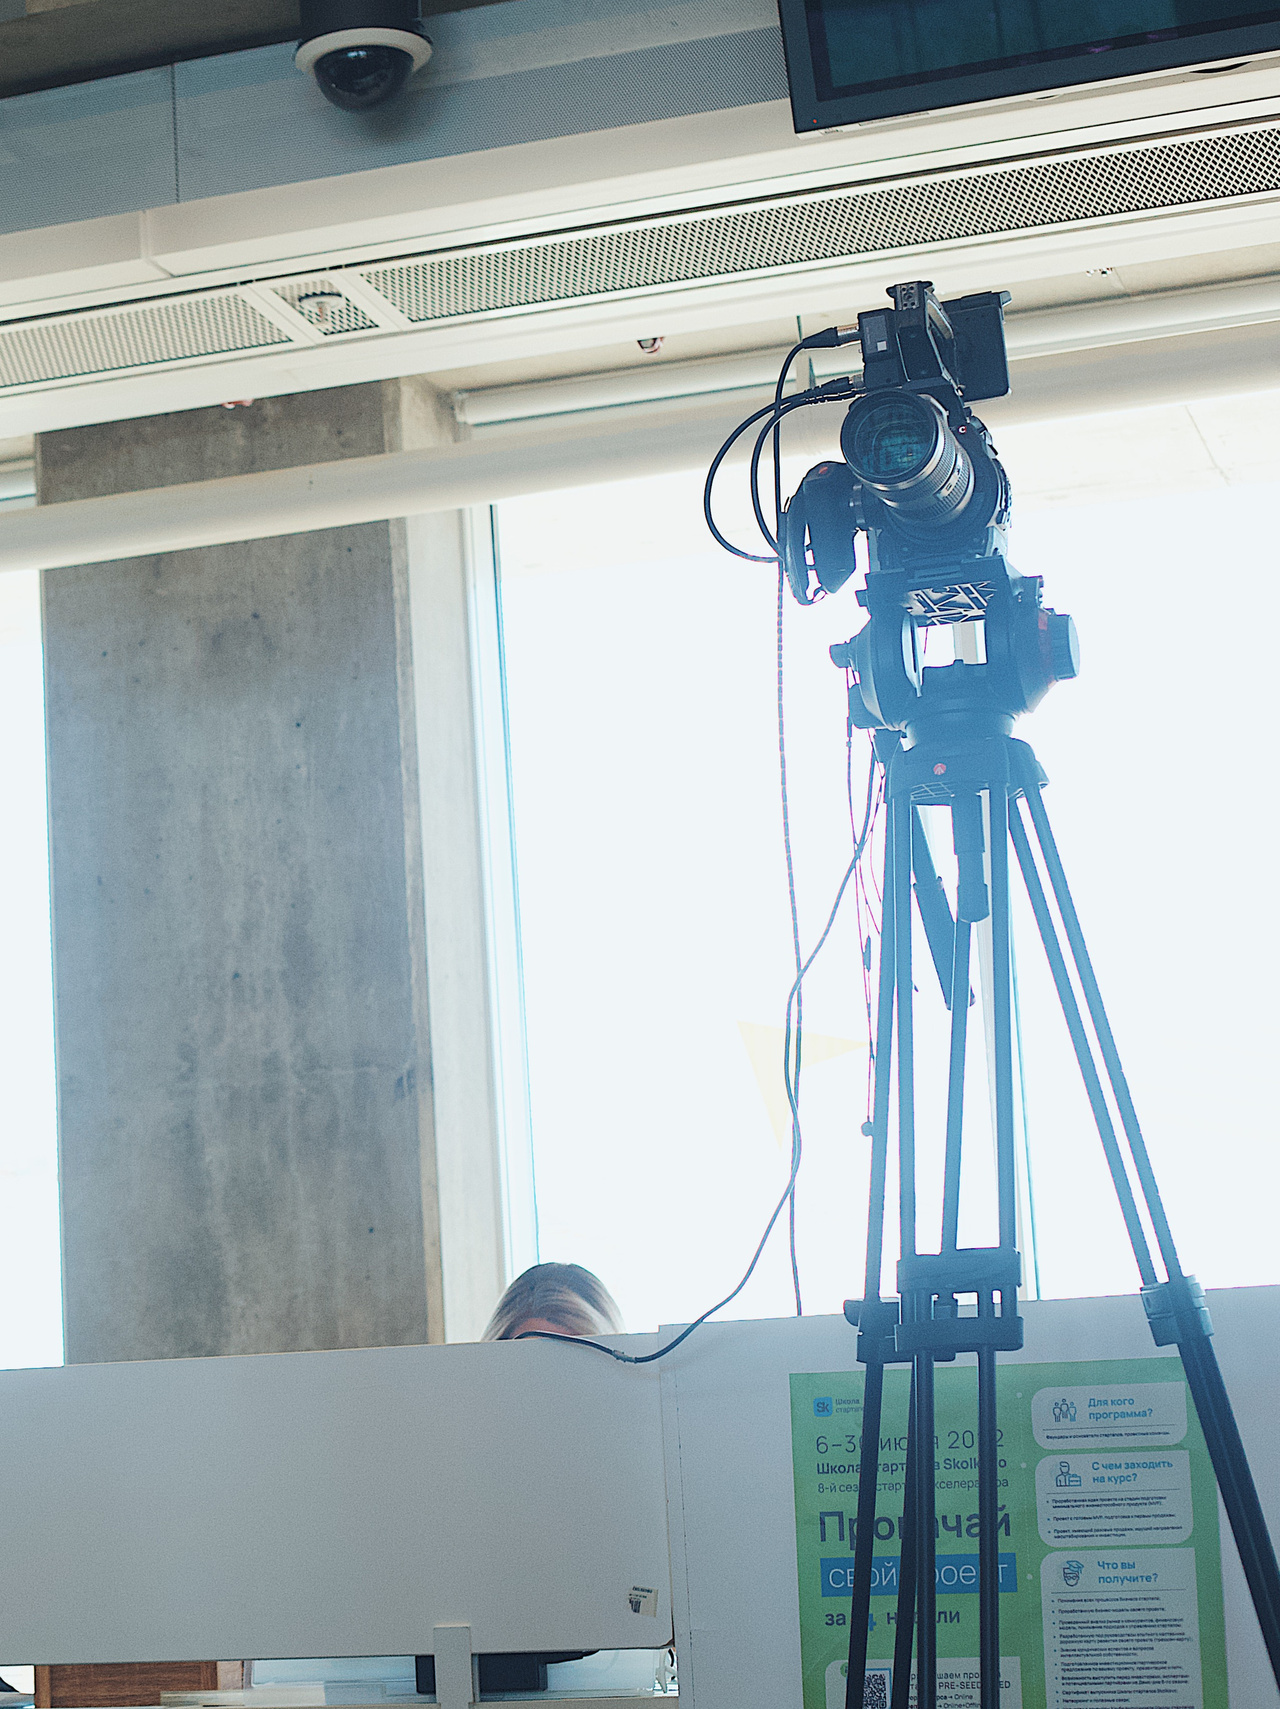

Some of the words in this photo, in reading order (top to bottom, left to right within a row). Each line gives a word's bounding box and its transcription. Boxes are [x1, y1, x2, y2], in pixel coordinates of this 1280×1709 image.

[816, 1401, 830, 1413] Sk
[1088, 1398, 1109, 1408] Для
[1111, 1398, 1135, 1406] кого
[1088, 1408, 1153, 1422] программа?
[880, 1436, 939, 1451] июя
[947, 1429, 1004, 1449] 202
[817, 1462, 862, 1474] Школа
[943, 1458, 1007, 1470] Skolko
[1092, 1461, 1100, 1471] С
[1102, 1462, 1122, 1470] чем
[1124, 1460, 1174, 1471] заходить
[1092, 1475, 1105, 1483] на
[1107, 1473, 1138, 1484] курс?
[818, 1482, 837, 1493] 8-й
[839, 1483, 860, 1493] сез
[820, 1504, 1011, 1551] Прочай
[1097, 1560, 1119, 1570] Что
[1120, 1561, 1136, 1570] вы
[1098, 1573, 1159, 1586] получите?
[825, 1613, 846, 1626] за
[886, 1610, 960, 1625] нли
